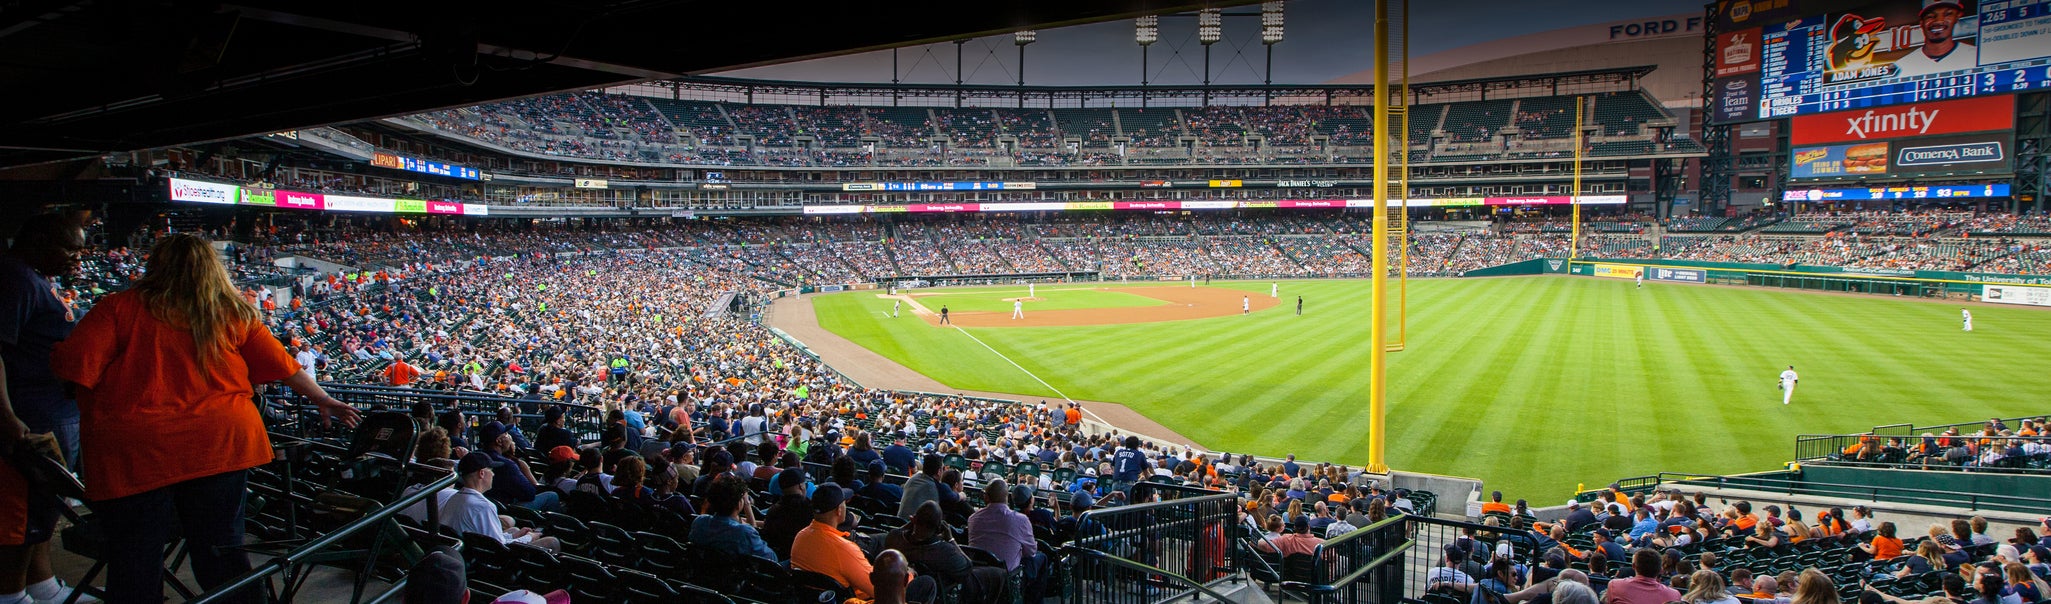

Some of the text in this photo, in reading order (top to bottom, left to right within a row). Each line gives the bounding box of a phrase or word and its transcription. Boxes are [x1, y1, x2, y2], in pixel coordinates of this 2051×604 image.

[1982, 7, 2028, 23] .265 5
[1609, 19, 1678, 39] FORD
[1890, 26, 1912, 51] 10
[1831, 70, 1858, 82] ADAM
[1859, 66, 1889, 78] JONES
[1984, 73, 1996, 86] 3
[2014, 70, 2026, 82] 2
[1723, 96, 1748, 106] Team
[1772, 96, 1804, 106] ORIOLES
[1772, 106, 1798, 116] TIGERS
[1846, 107, 1939, 138] xfinity
[1962, 146, 1994, 158] Bank
[374, 154, 396, 167] LIPARI
[1277, 180, 1290, 188] JACK
[1290, 180, 1310, 188] DANIEL'S
[1658, 269, 1672, 279] Lite
[1982, 276, 2025, 284] University
[1120, 458, 1127, 472] 1
